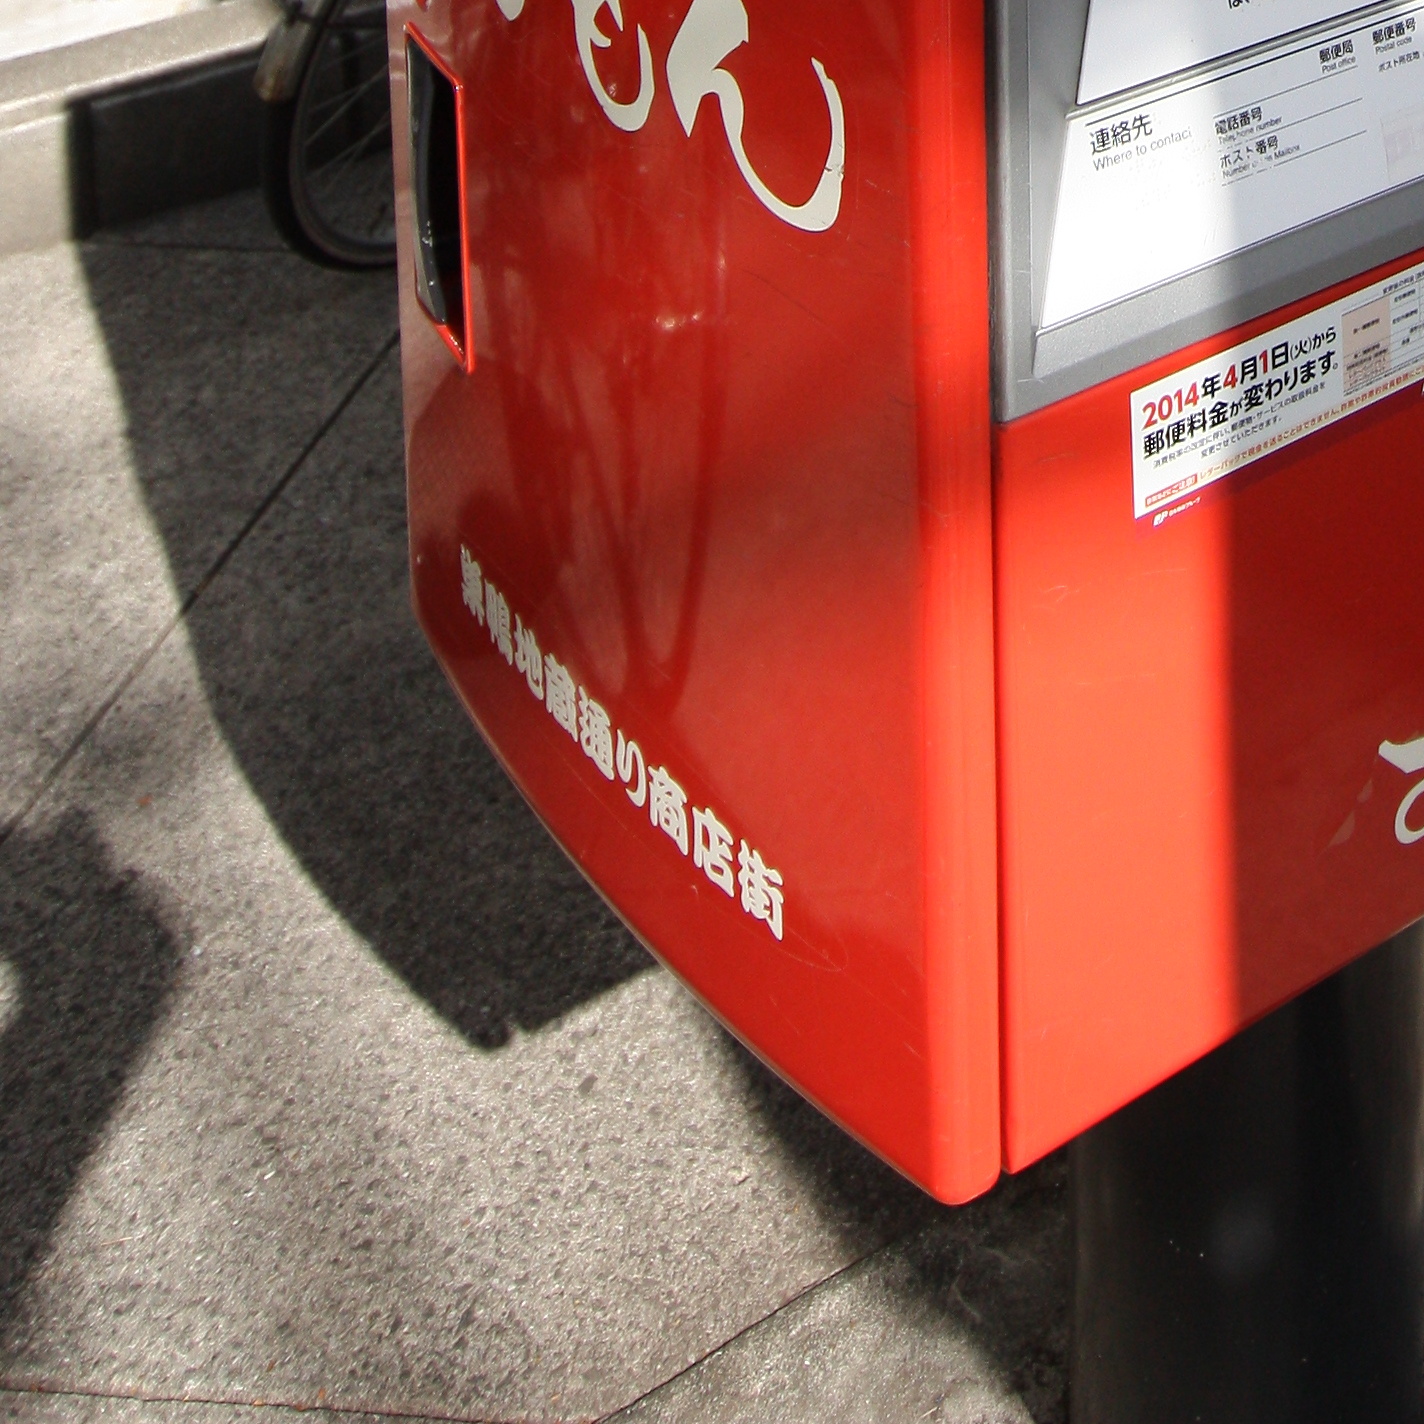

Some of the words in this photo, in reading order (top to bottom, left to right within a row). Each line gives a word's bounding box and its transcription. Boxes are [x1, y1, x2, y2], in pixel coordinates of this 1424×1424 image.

[1318, 38, 1355, 65] 郵便局
[1372, 16, 1417, 46] 郵便番号
[1089, 112, 1154, 157] 連絡先
[1092, 148, 1133, 172] Where
[1135, 143, 1148, 157] to
[1141, 325, 1337, 432] 2014年4月1日(火)から
[1143, 349, 1339, 461] 郵便料金が変わります。
[459, 542, 785, 942] 巣鴨地蔵通り商店街
